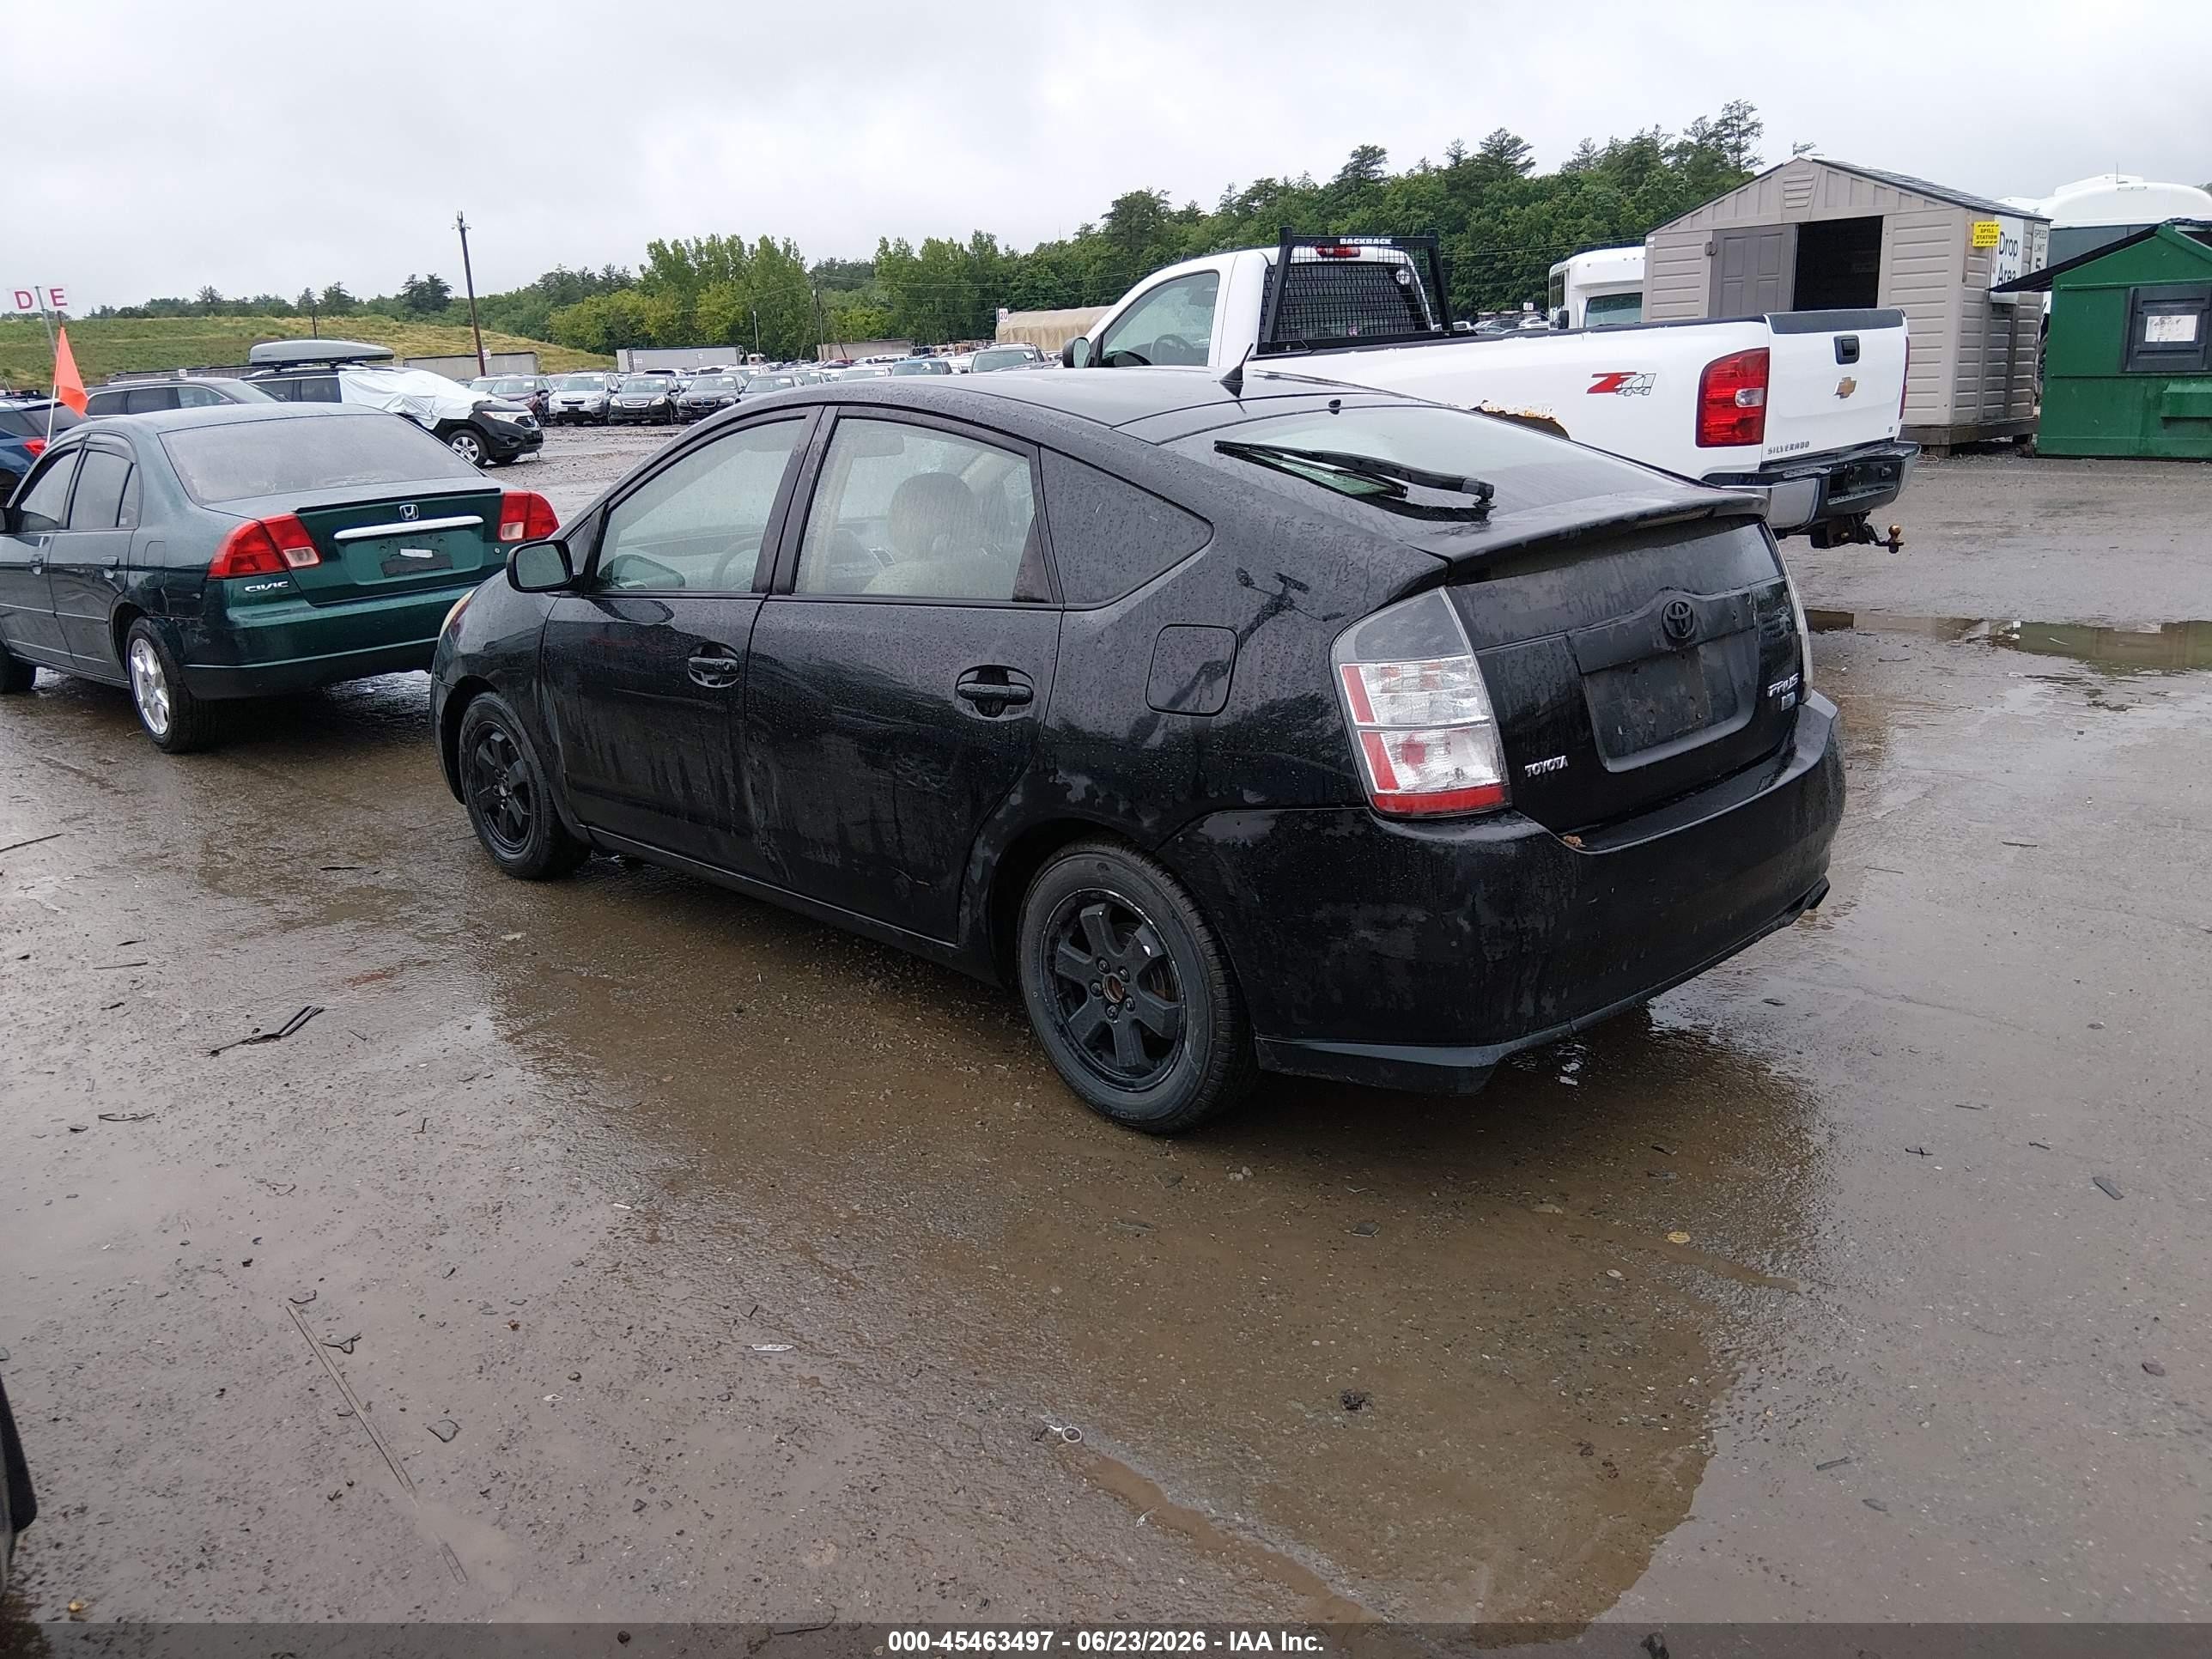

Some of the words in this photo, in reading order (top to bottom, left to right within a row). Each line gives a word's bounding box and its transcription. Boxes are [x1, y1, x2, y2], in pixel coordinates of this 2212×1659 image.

[2034, 228, 2048, 240] SPEED
[1999, 231, 2019, 261] Drop
[2033, 243, 2046, 252] LIMIT
[2035, 258, 2041, 270] 5
[1000, 311, 1008, 320] 20
[1767, 441, 1810, 455] SILVERADO
[244, 580, 289, 592] CIVIC
[1524, 755, 1569, 778] TOYOTA
